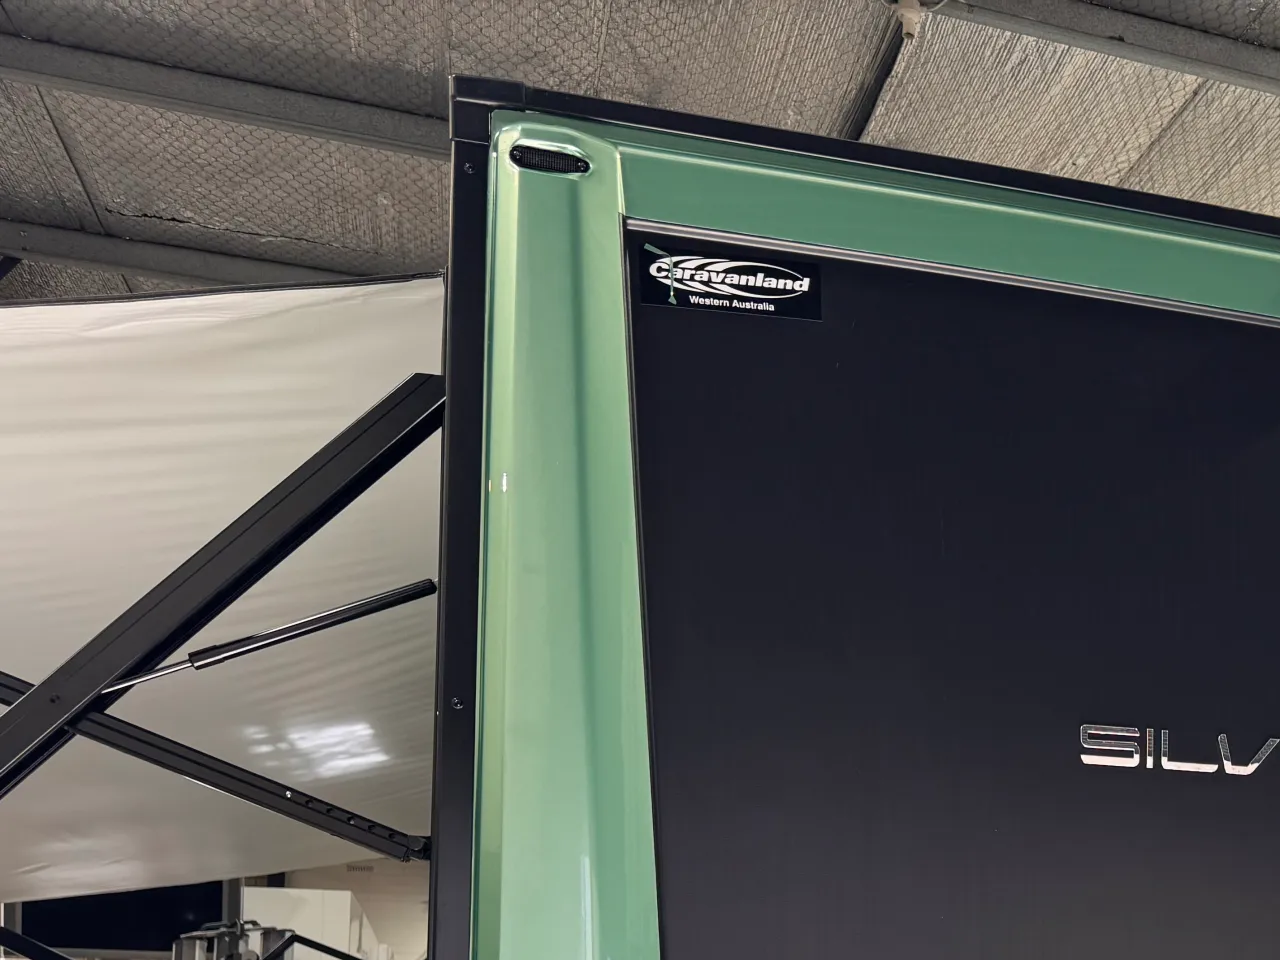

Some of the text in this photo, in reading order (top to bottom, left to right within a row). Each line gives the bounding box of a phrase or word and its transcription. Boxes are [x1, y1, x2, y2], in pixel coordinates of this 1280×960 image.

[649, 261, 810, 292] Caravanland
[689, 294, 775, 312] Western Australia
